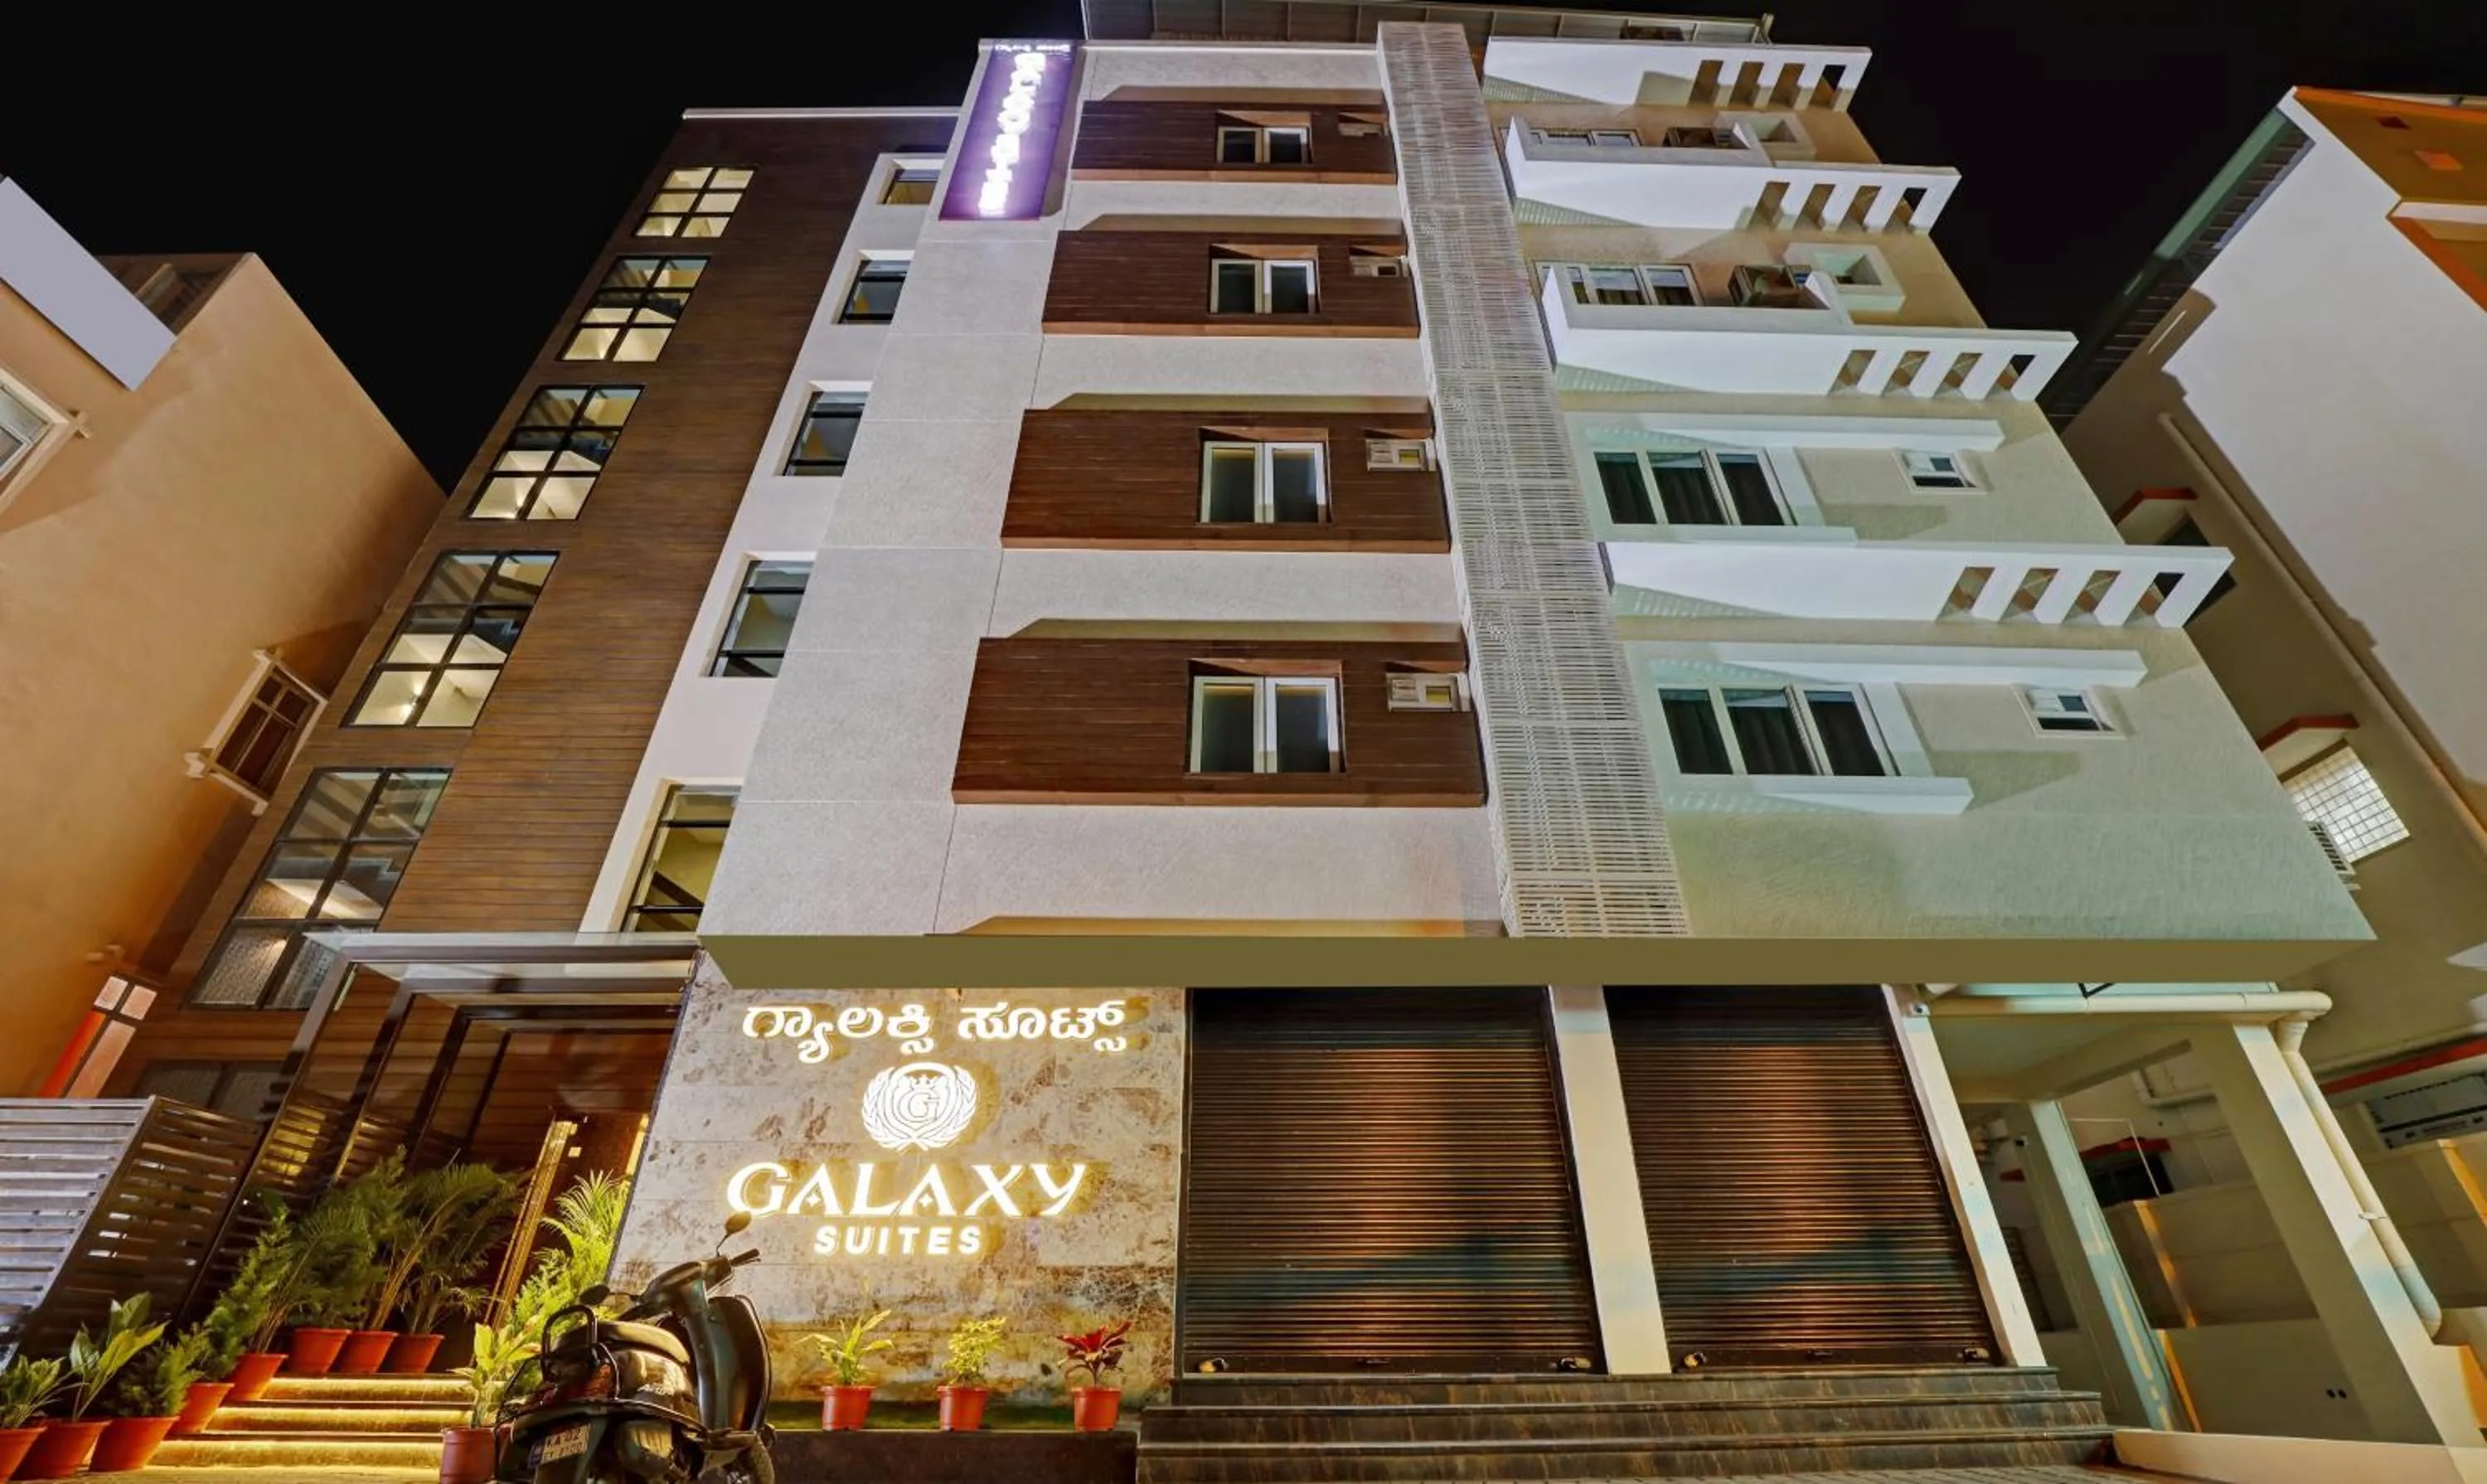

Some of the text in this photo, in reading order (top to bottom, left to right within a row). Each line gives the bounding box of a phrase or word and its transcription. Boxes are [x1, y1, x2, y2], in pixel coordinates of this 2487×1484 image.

[743, 1004, 936, 1065] ಗ್ಯಾಲಕ್ಸಿ
[727, 1161, 1087, 1215] GALAXY
[814, 1225, 982, 1256] SUITES
